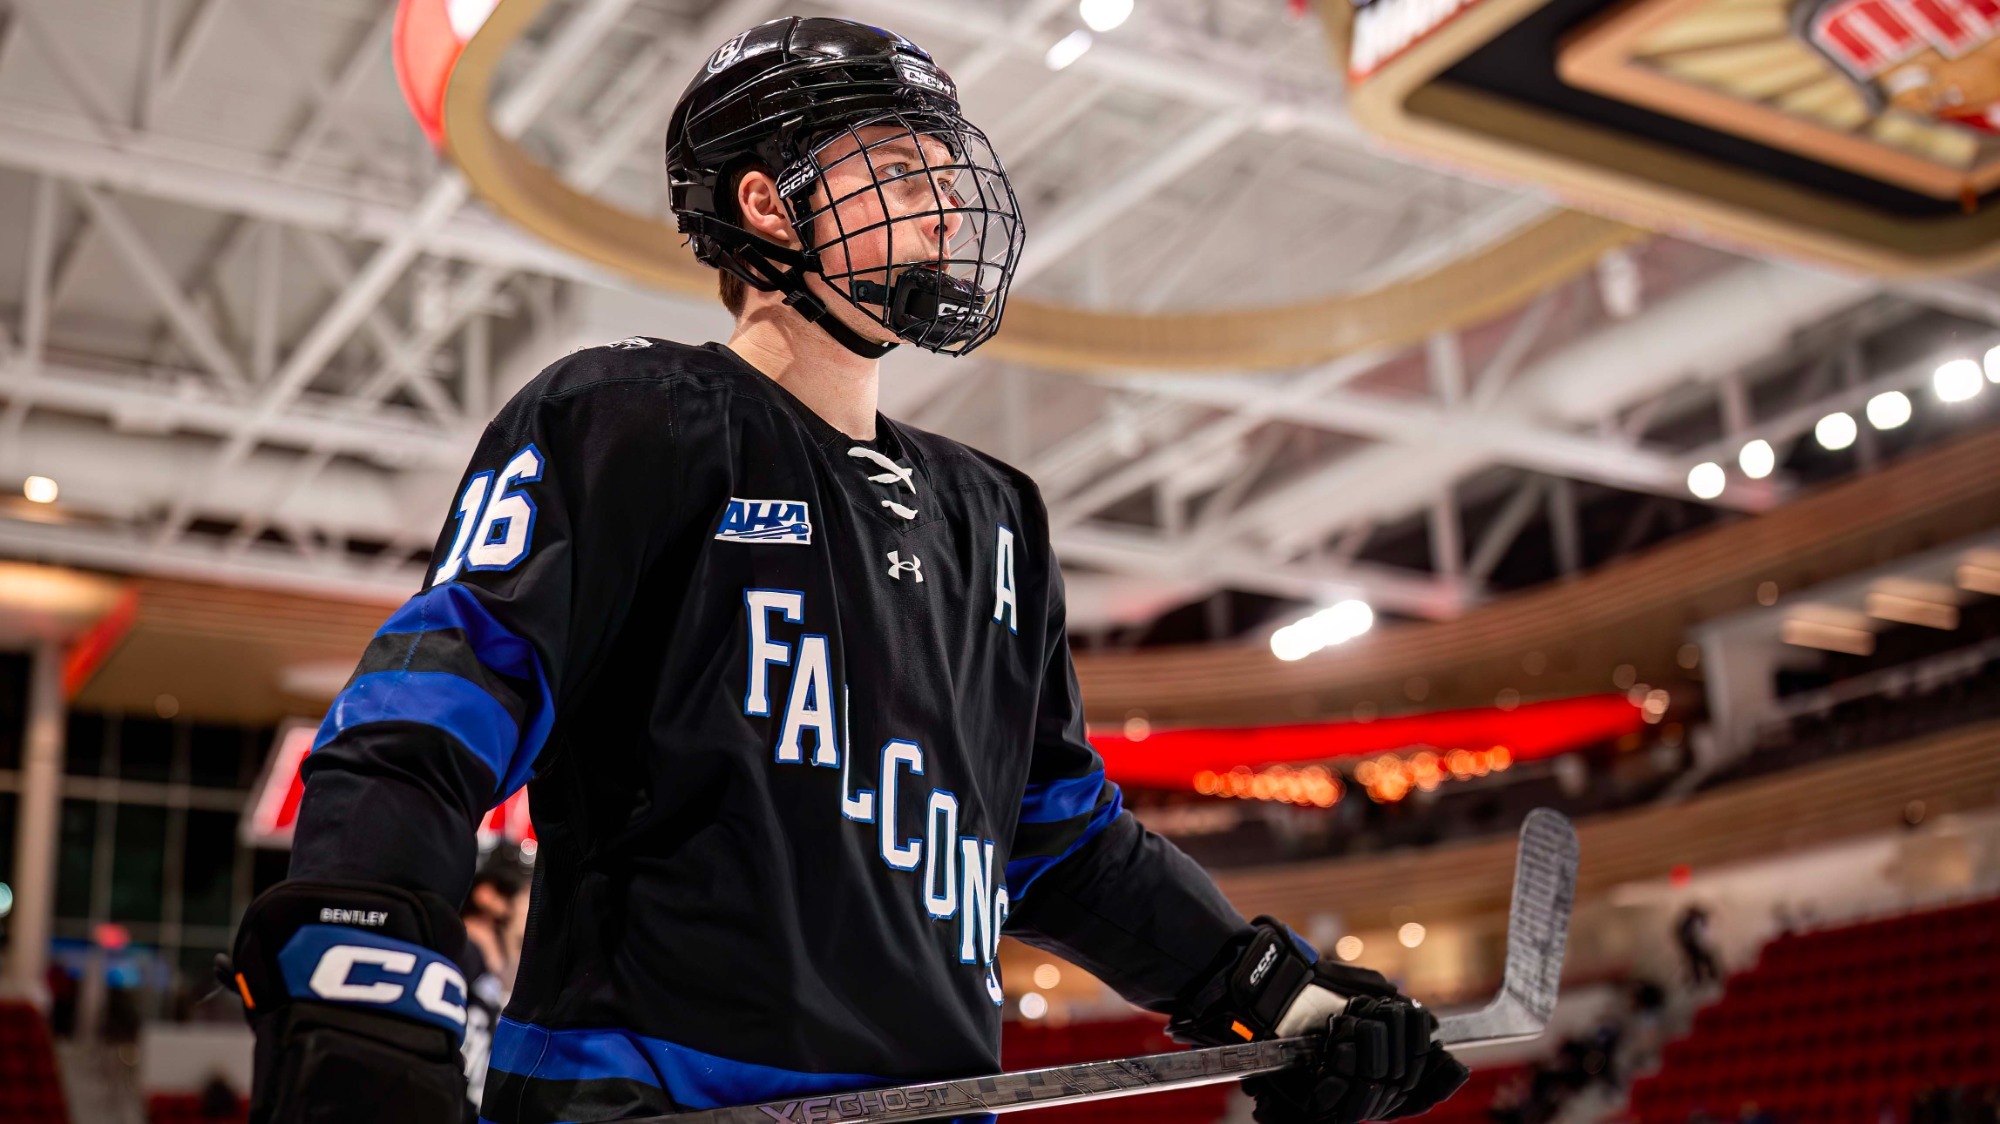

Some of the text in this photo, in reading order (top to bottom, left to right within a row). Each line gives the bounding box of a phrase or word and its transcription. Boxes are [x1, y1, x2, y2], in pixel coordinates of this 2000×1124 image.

[780, 169, 814, 197] CCM
[433, 444, 546, 587] 16
[717, 500, 807, 541] AHA
[993, 521, 1018, 635] A
[743, 588, 1009, 1005] FALCONS
[319, 907, 388, 926] BENTLEY
[1250, 943, 1276, 985] CCM
[835, 1085, 949, 1118] GHOST
